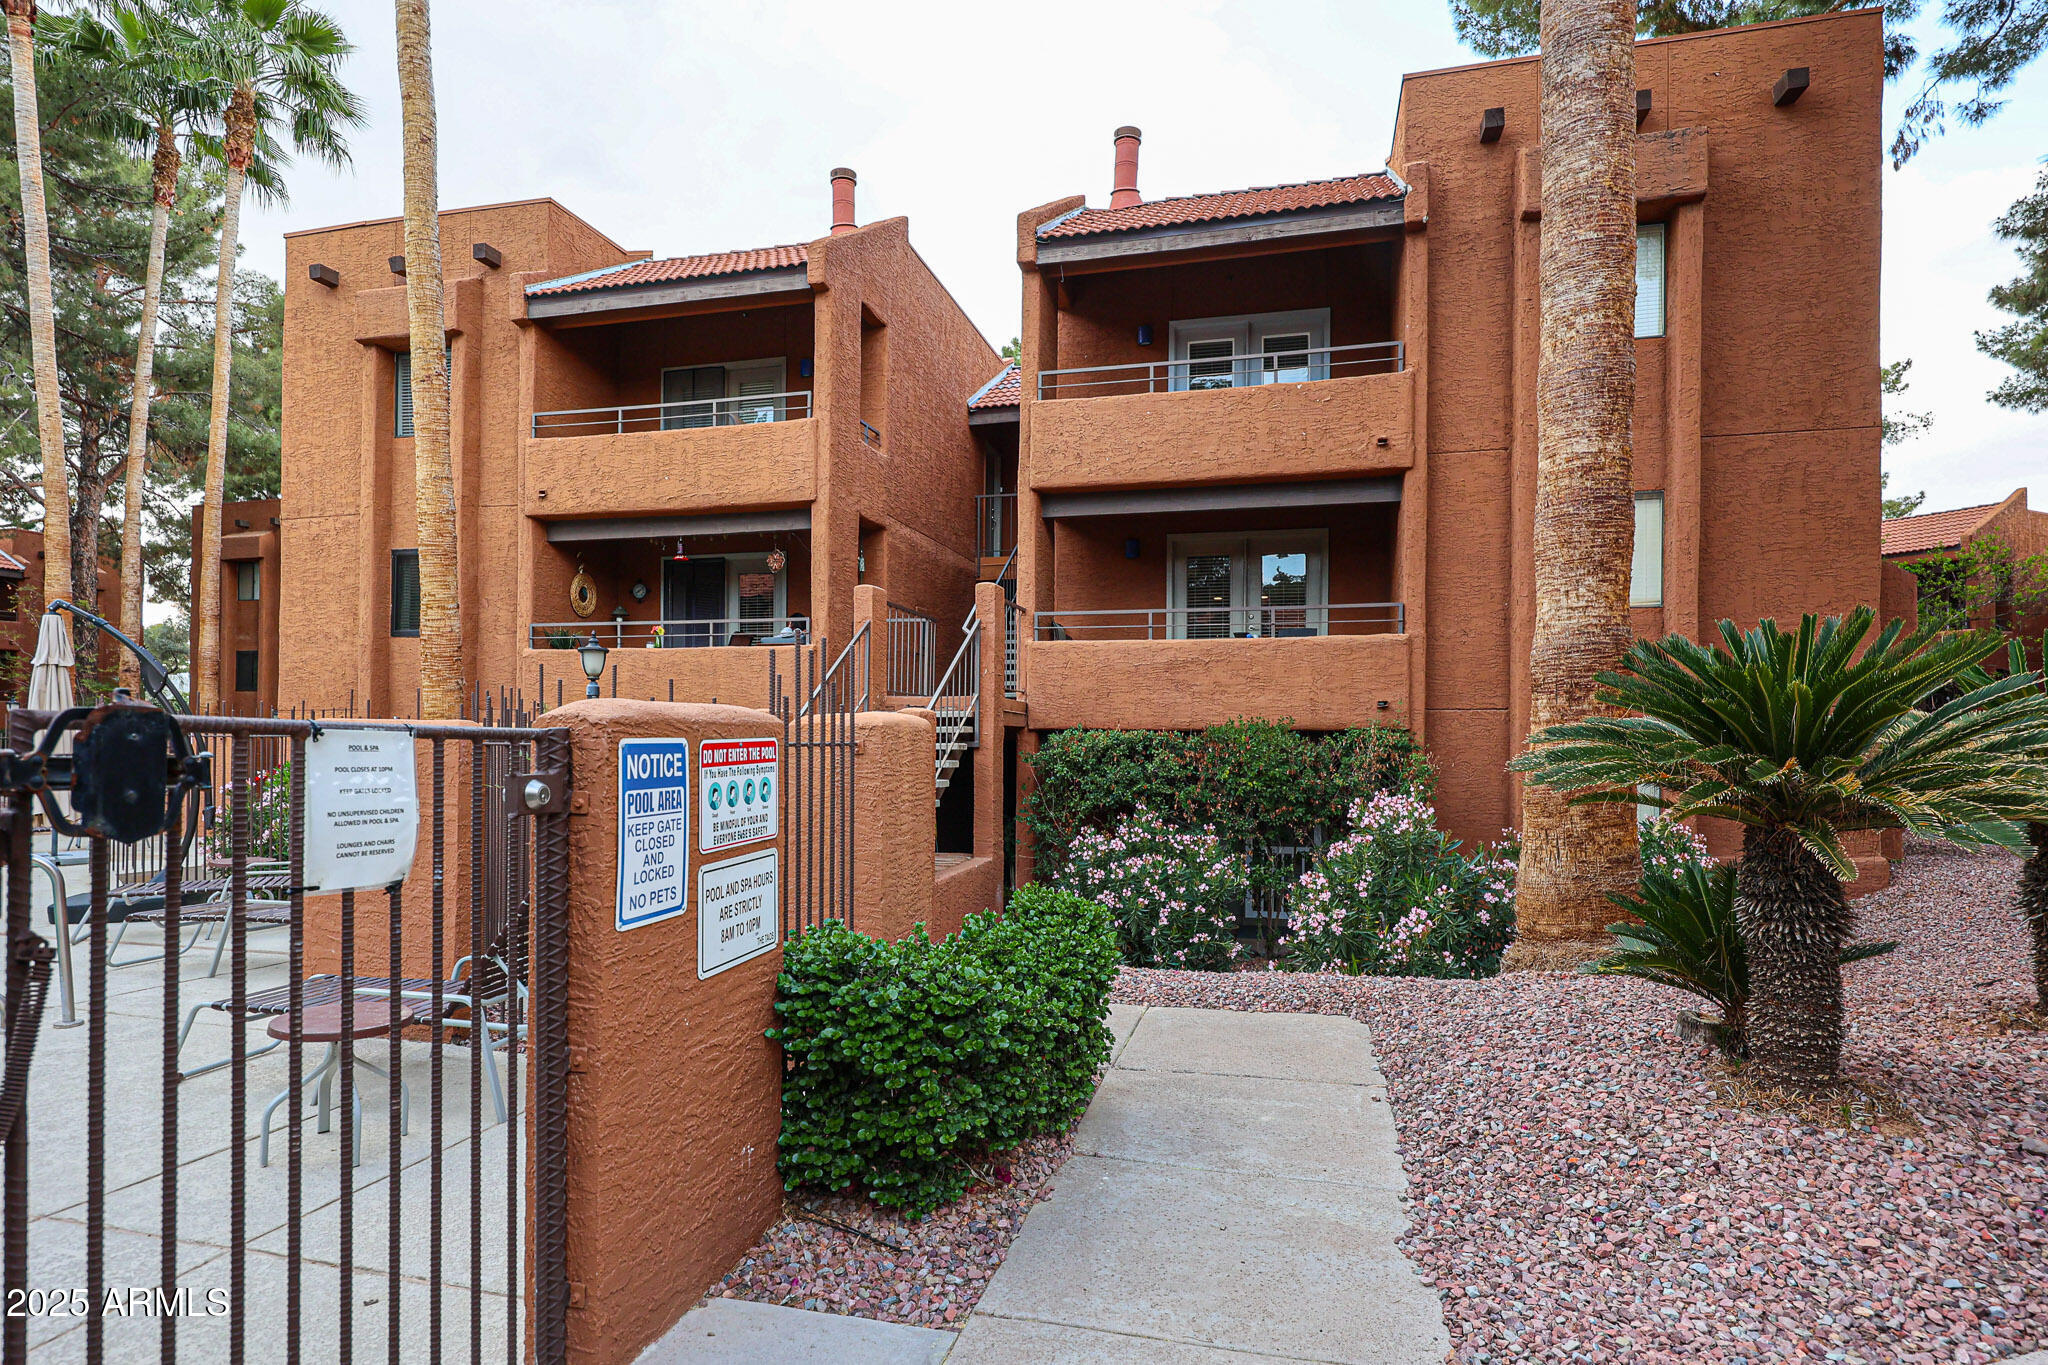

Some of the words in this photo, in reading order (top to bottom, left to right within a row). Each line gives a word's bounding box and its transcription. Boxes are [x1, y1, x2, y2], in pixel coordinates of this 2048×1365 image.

[703, 749, 713, 764] DO
[714, 748, 727, 763] NOT
[728, 747, 748, 762] ENTER
[748, 746, 760, 761] THE
[761, 746, 776, 760] POOL
[627, 753, 683, 780] NOTICE
[709, 768, 717, 779] You
[717, 768, 728, 778] Have
[728, 767, 736, 776] The
[737, 766, 755, 776] Following
[756, 764, 775, 776] Symptoms
[627, 791, 655, 815] POOL
[657, 789, 682, 811] AREA
[334, 819, 361, 827] ALLOWED
[337, 809, 379, 817] UNSUPERVISED
[713, 822, 719, 833] BE
[720, 818, 740, 831] MINDFUL
[740, 817, 747, 827] OF
[747, 814, 758, 826] YOUR
[759, 813, 769, 823] AND
[627, 821, 655, 838] KEEP
[657, 817, 682, 833] GATE
[713, 831, 737, 846] EVERYONE
[752, 825, 769, 837] SAFETY
[336, 841, 363, 849] LOUNGES
[377, 838, 396, 846] CHAIRS
[336, 851, 360, 859] CANNOT
[369, 848, 395, 856] RESERVED
[635, 834, 675, 853] CLOSED
[643, 851, 664, 868] AND
[633, 864, 674, 885] LOCKED
[705, 885, 724, 904] POOL
[725, 881, 739, 897] AND
[740, 877, 753, 893] SPA
[753, 870, 773, 889] HOURS
[629, 893, 647, 911] NO
[649, 885, 677, 906] PETS
[719, 904, 733, 922] ARE
[734, 894, 763, 917] STRICTLY
[720, 925, 735, 943] 8AM
[735, 922, 745, 937] TO
[745, 915, 761, 934] 10PM
